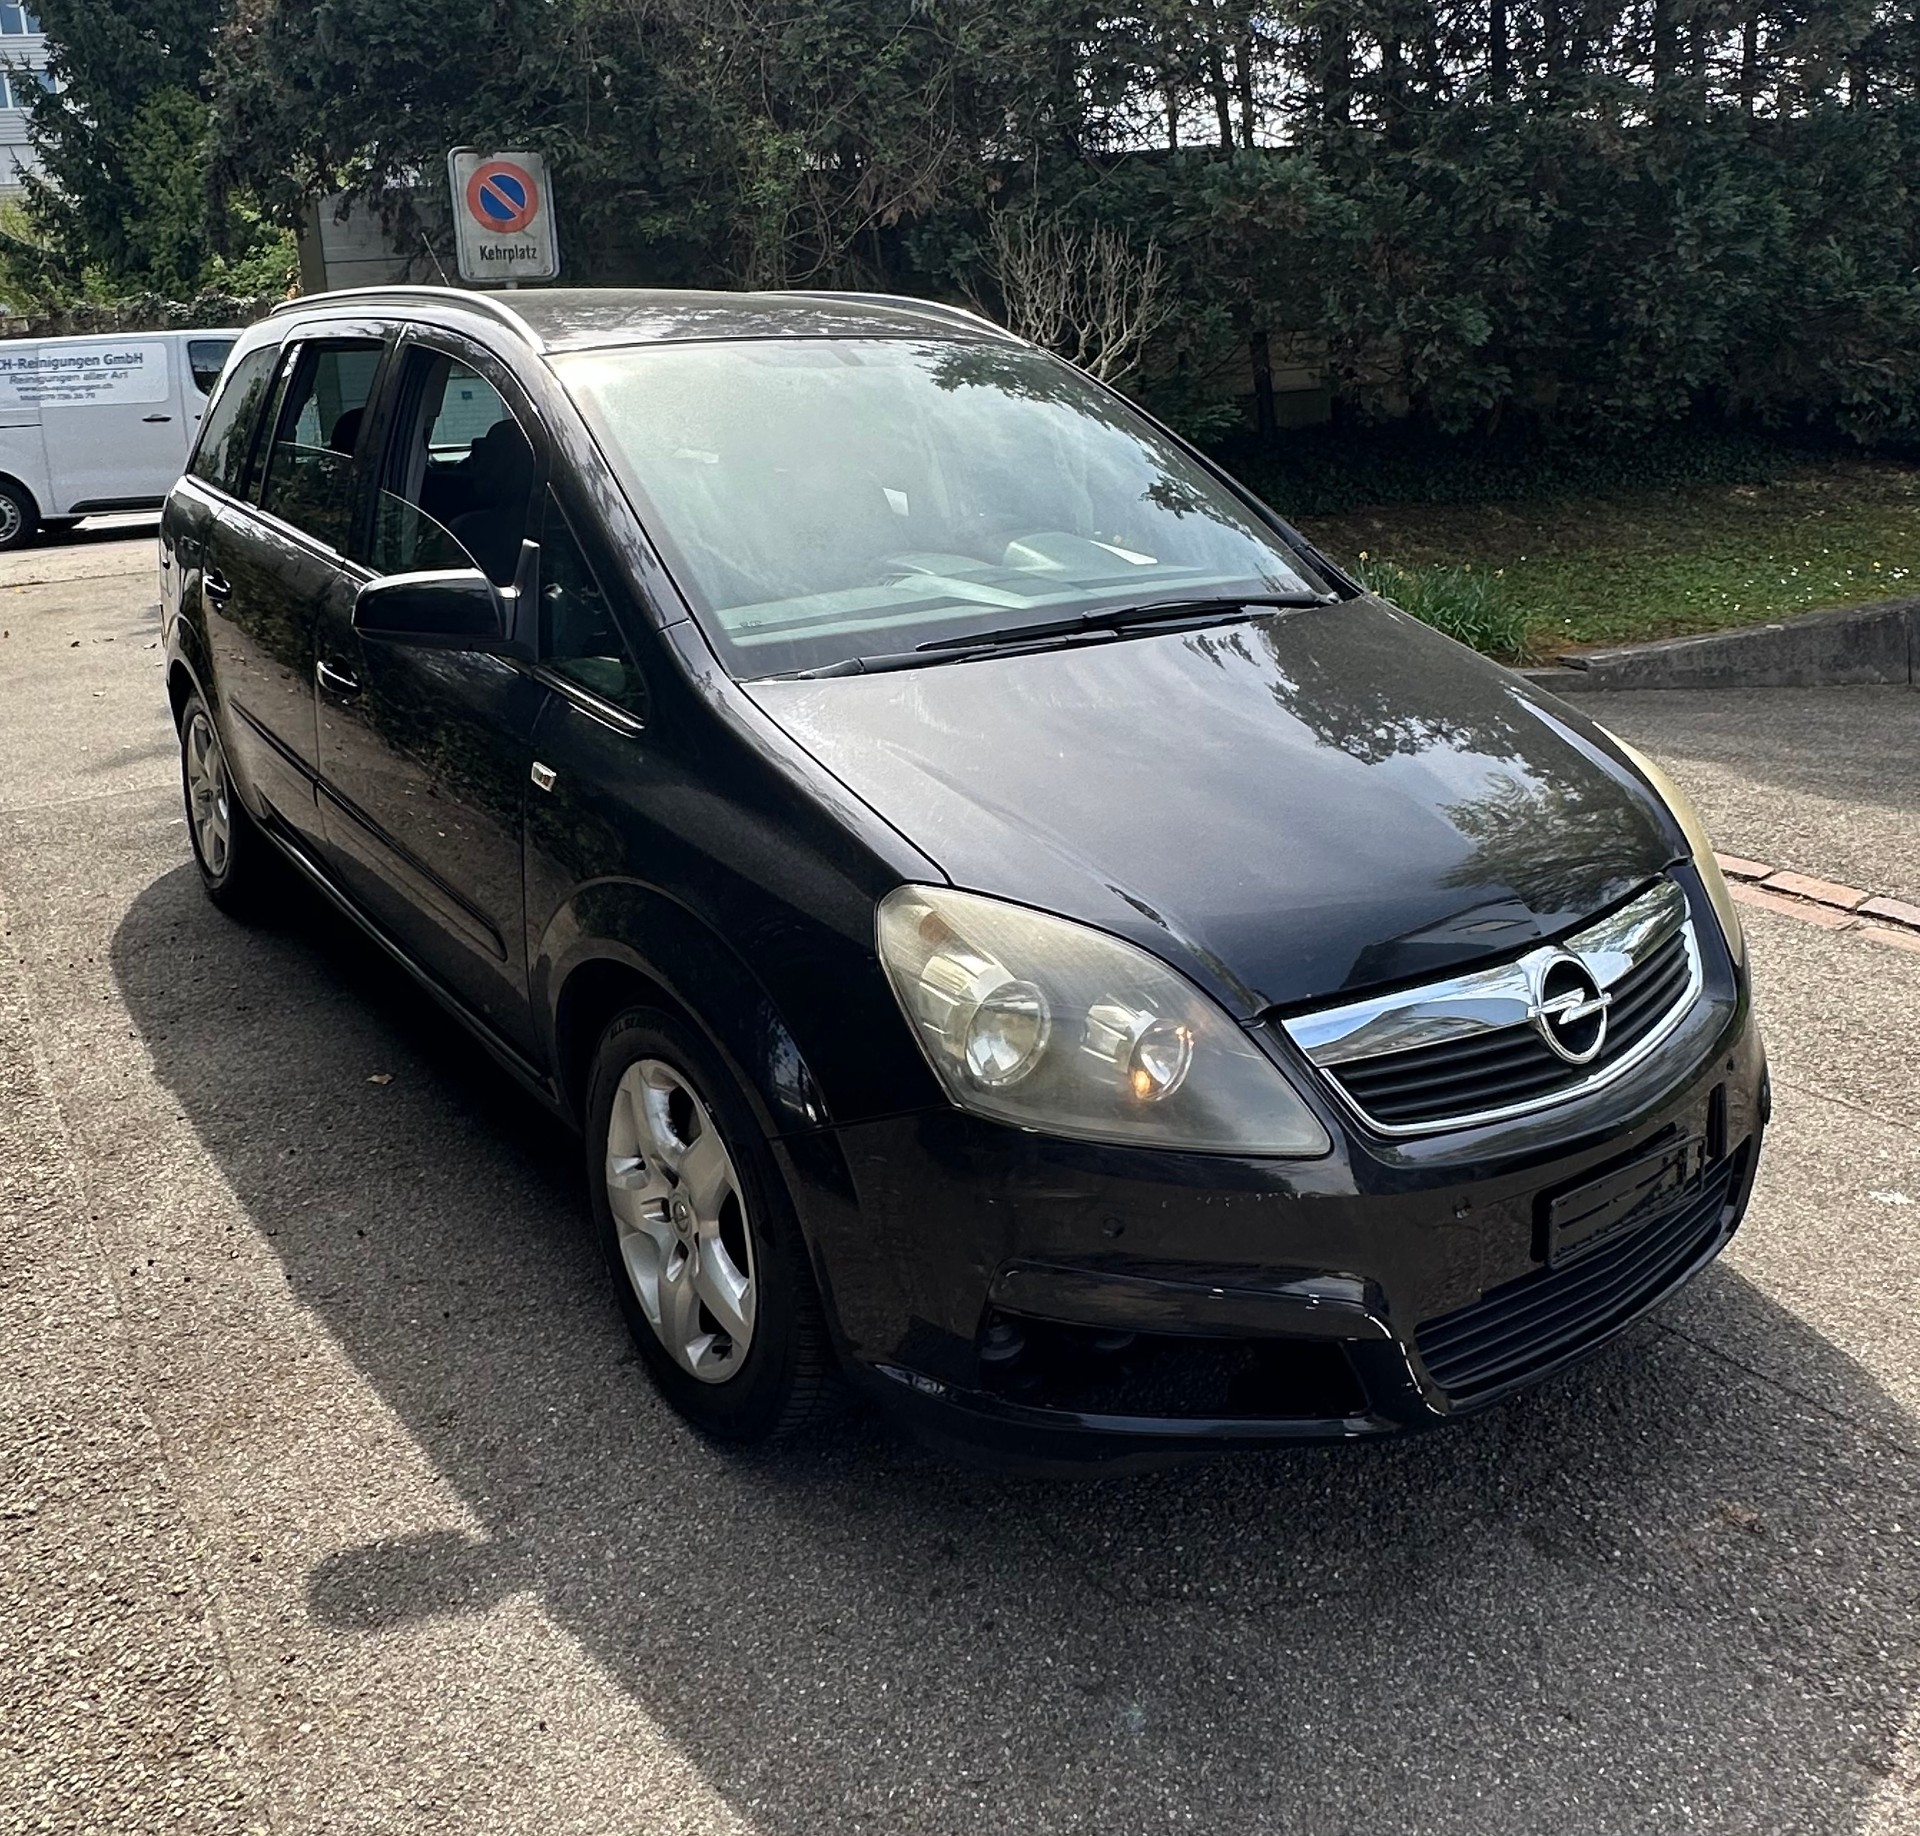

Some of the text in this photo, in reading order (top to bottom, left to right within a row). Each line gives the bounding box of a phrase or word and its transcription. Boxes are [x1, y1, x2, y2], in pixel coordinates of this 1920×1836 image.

[479, 244, 538, 264] Kehrplatz
[103, 352, 143, 365] GmbH
[9, 374, 80, 384] Reinigungen
[111, 371, 129, 380] Art
